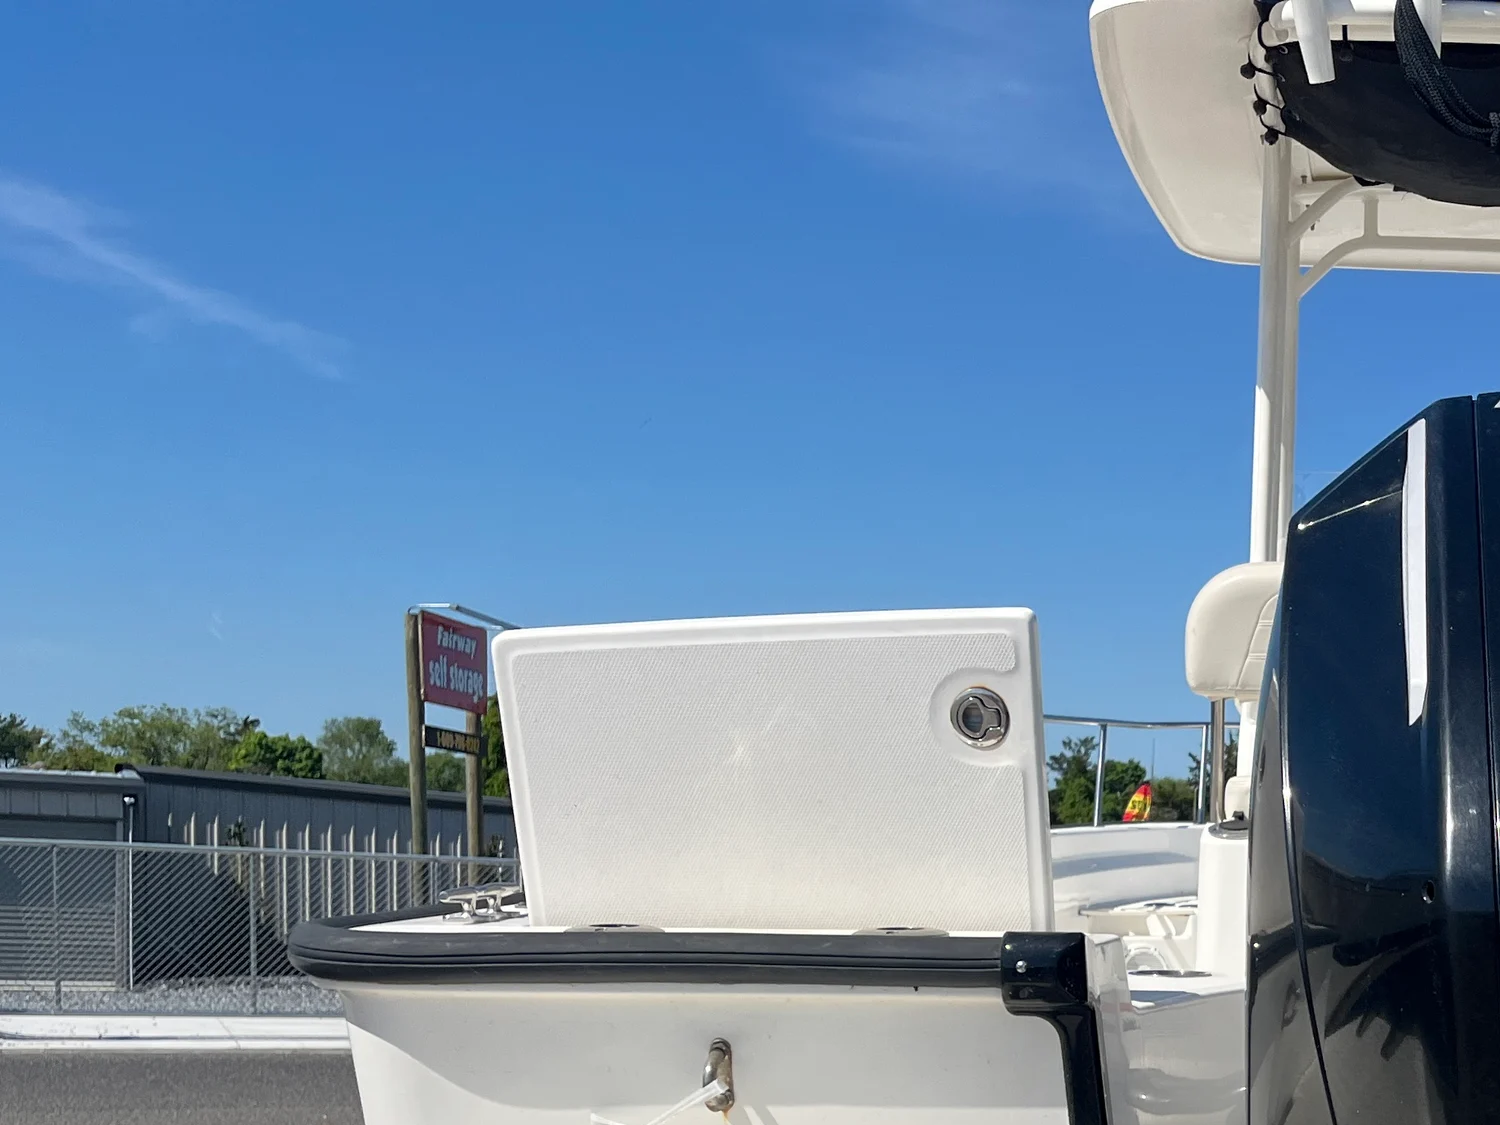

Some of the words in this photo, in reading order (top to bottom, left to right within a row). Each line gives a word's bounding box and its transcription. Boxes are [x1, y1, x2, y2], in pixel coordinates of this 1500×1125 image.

[437, 625, 477, 660] Fairway
[429, 654, 448, 689] self
[449, 662, 484, 704] storage
